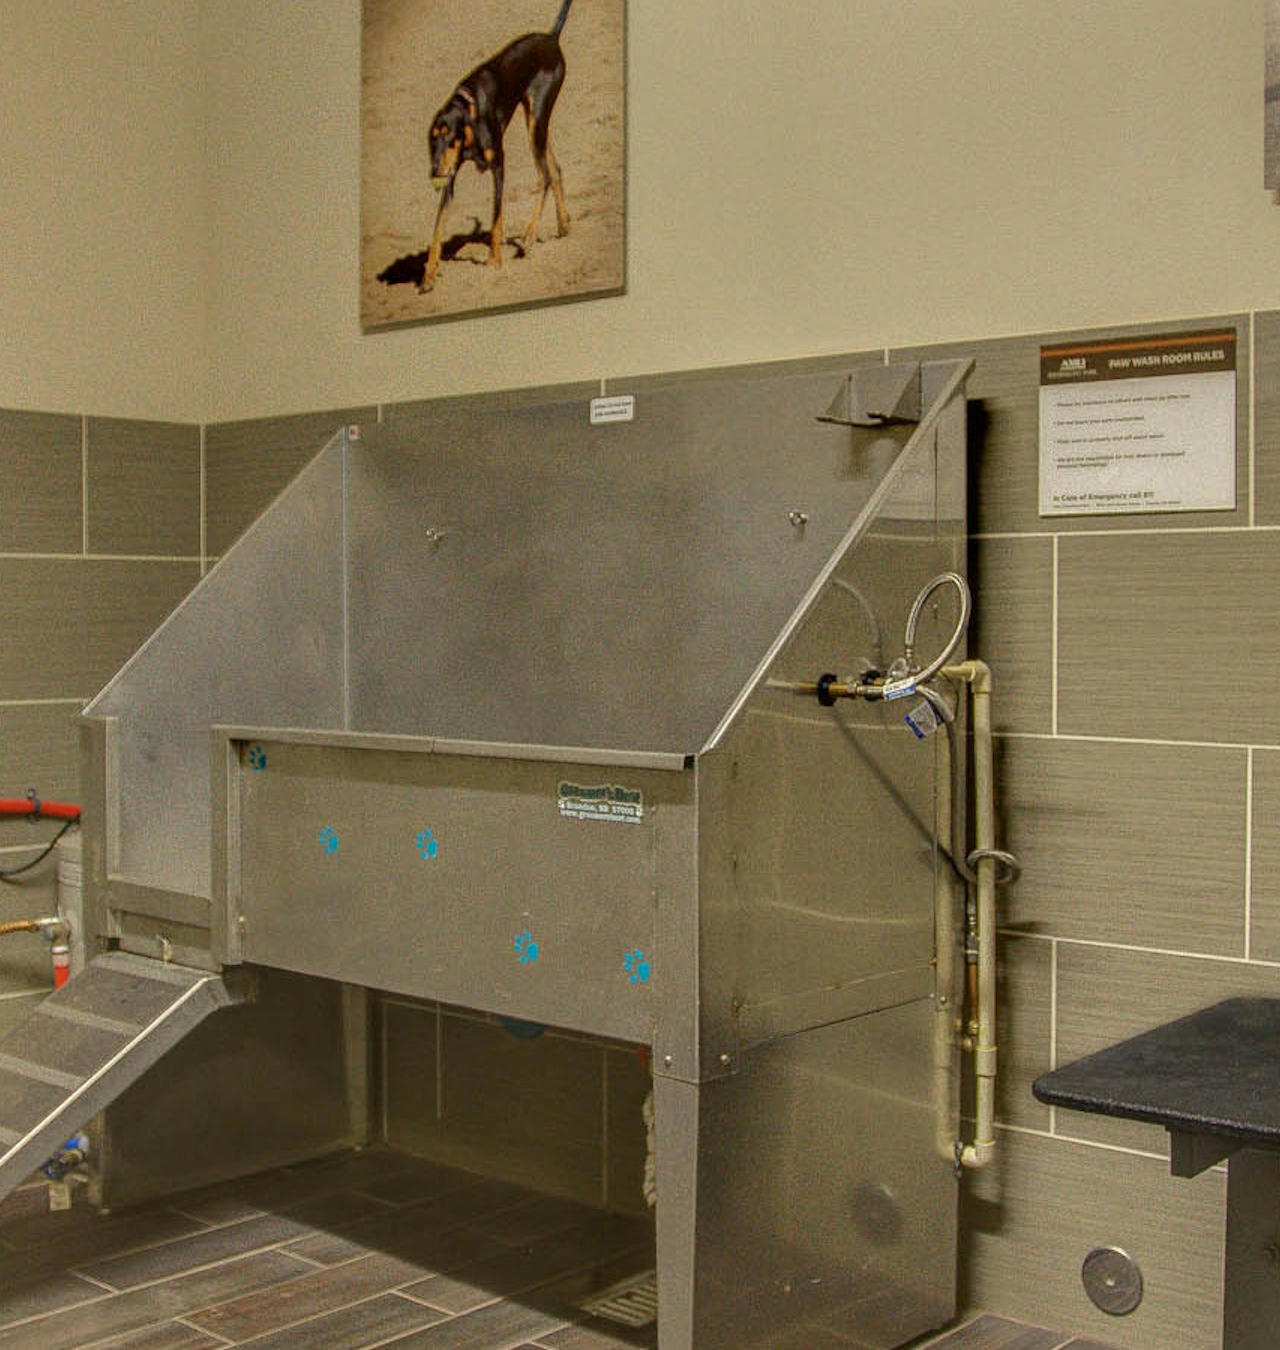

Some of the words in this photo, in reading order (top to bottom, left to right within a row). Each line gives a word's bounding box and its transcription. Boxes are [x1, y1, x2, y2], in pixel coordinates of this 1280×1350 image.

[1131, 356, 1160, 368] WASH
[1162, 353, 1191, 365] ROOM
[1193, 350, 1224, 361] RULES
